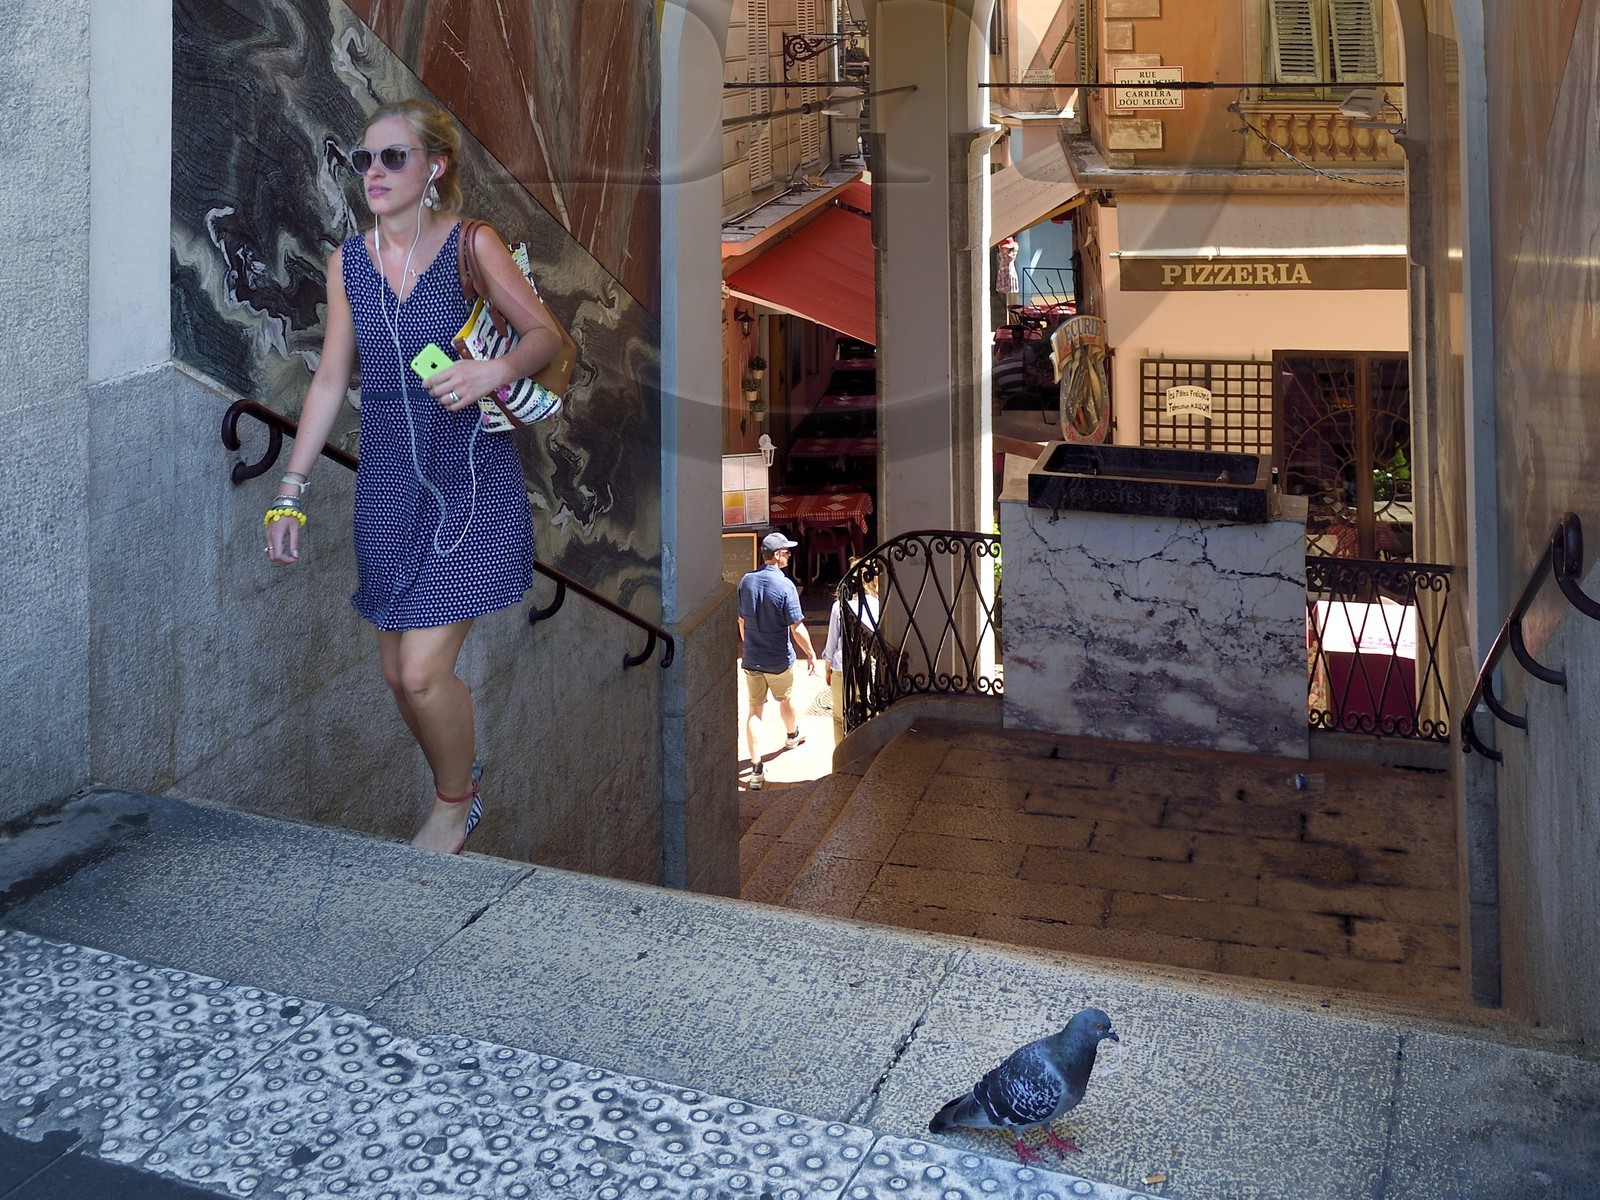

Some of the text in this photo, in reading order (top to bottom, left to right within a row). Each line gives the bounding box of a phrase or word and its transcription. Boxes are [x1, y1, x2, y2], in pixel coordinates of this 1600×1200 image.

[1143, 98, 1179, 106] MERCAT
[1161, 263, 1312, 286] PIZZERIA
[1092, 488, 1142, 504] POSTES
